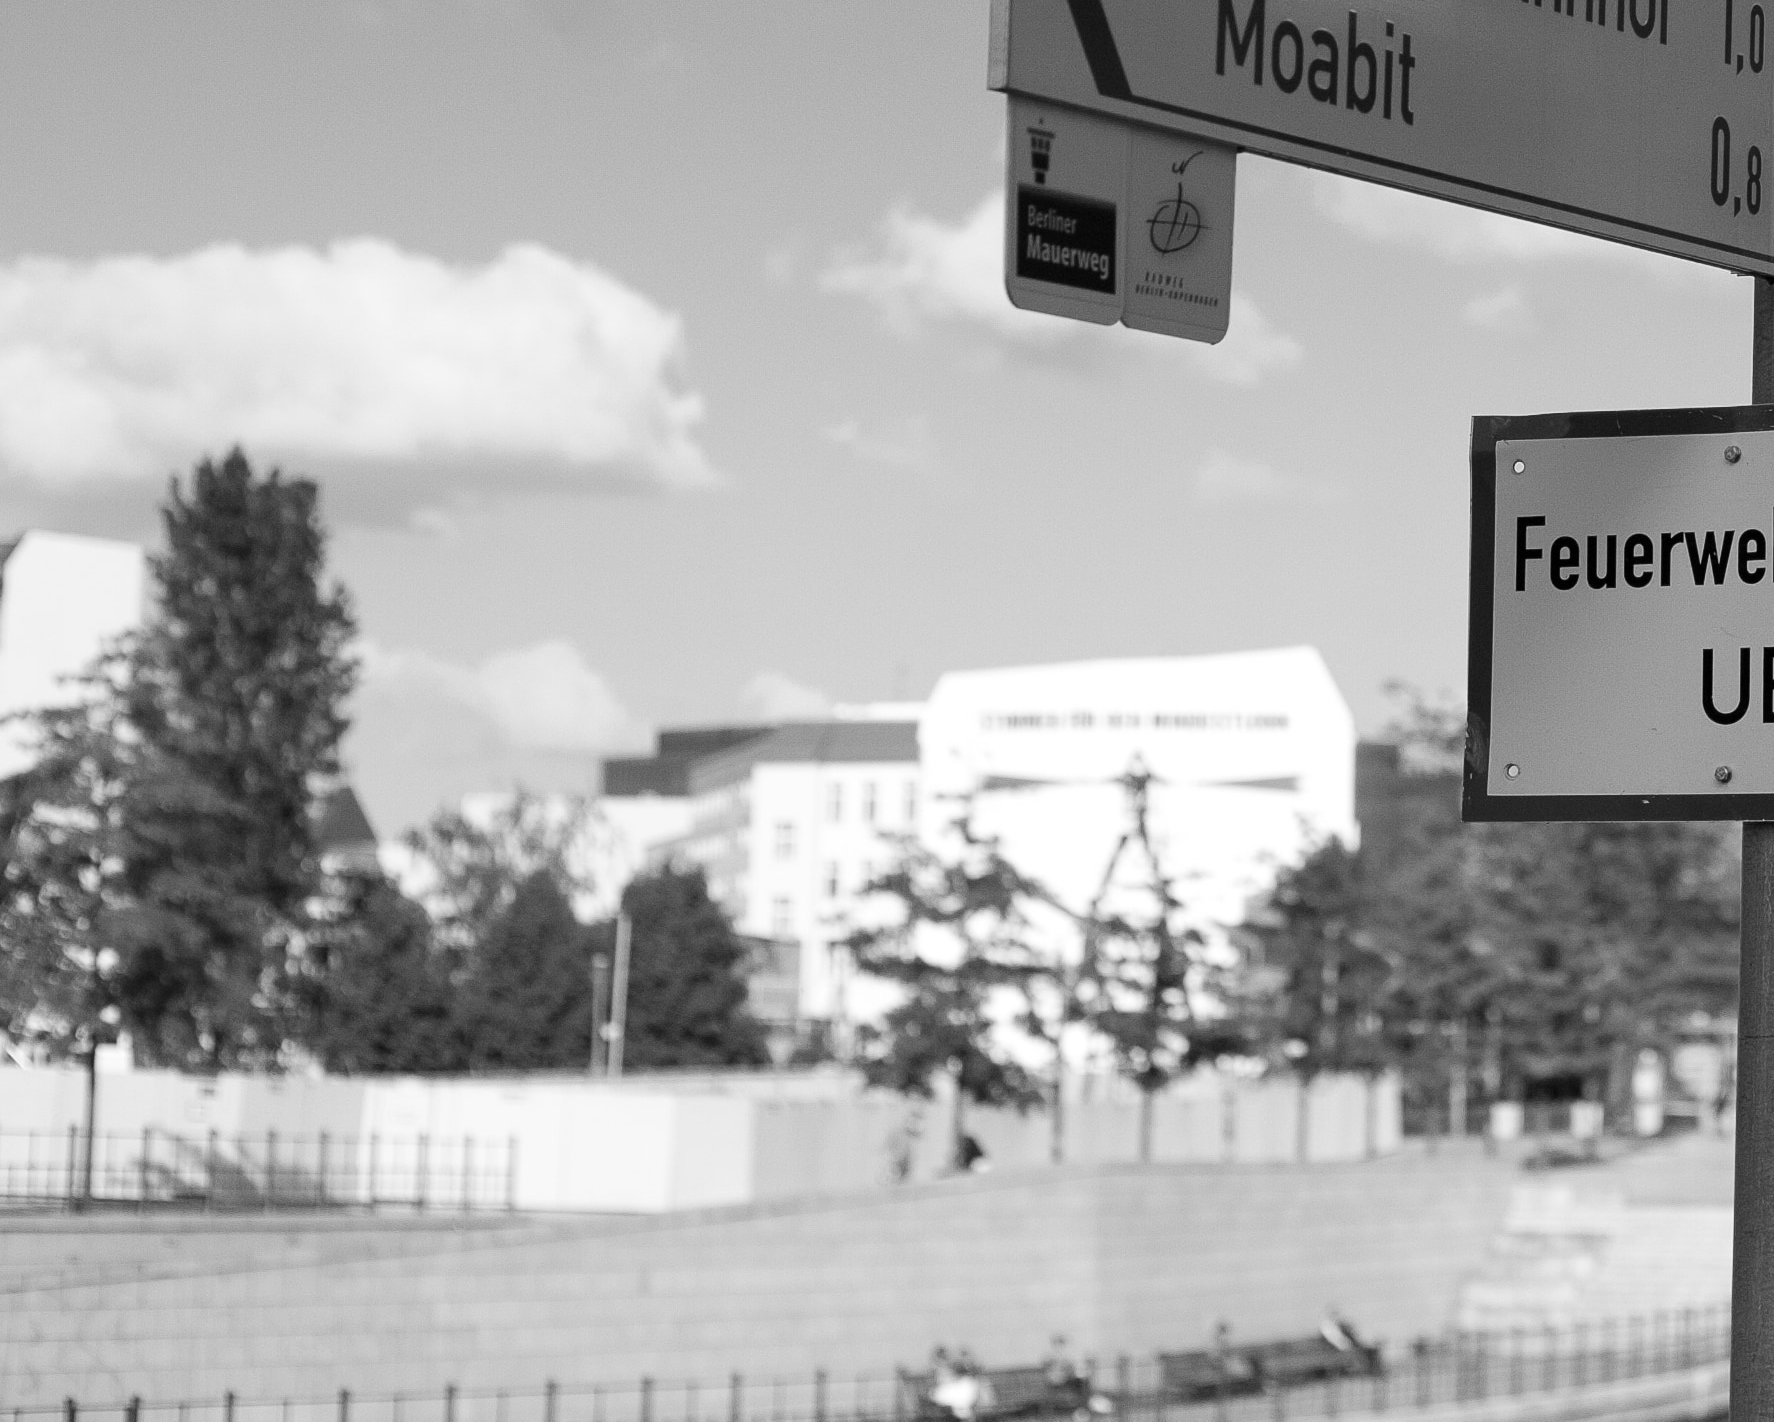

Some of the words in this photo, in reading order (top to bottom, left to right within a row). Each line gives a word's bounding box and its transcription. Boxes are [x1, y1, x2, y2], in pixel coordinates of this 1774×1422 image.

[1710, 116, 1762, 218] 0,8
[1027, 204, 1078, 234] Berliner
[1026, 233, 1110, 280] Mauerweg
